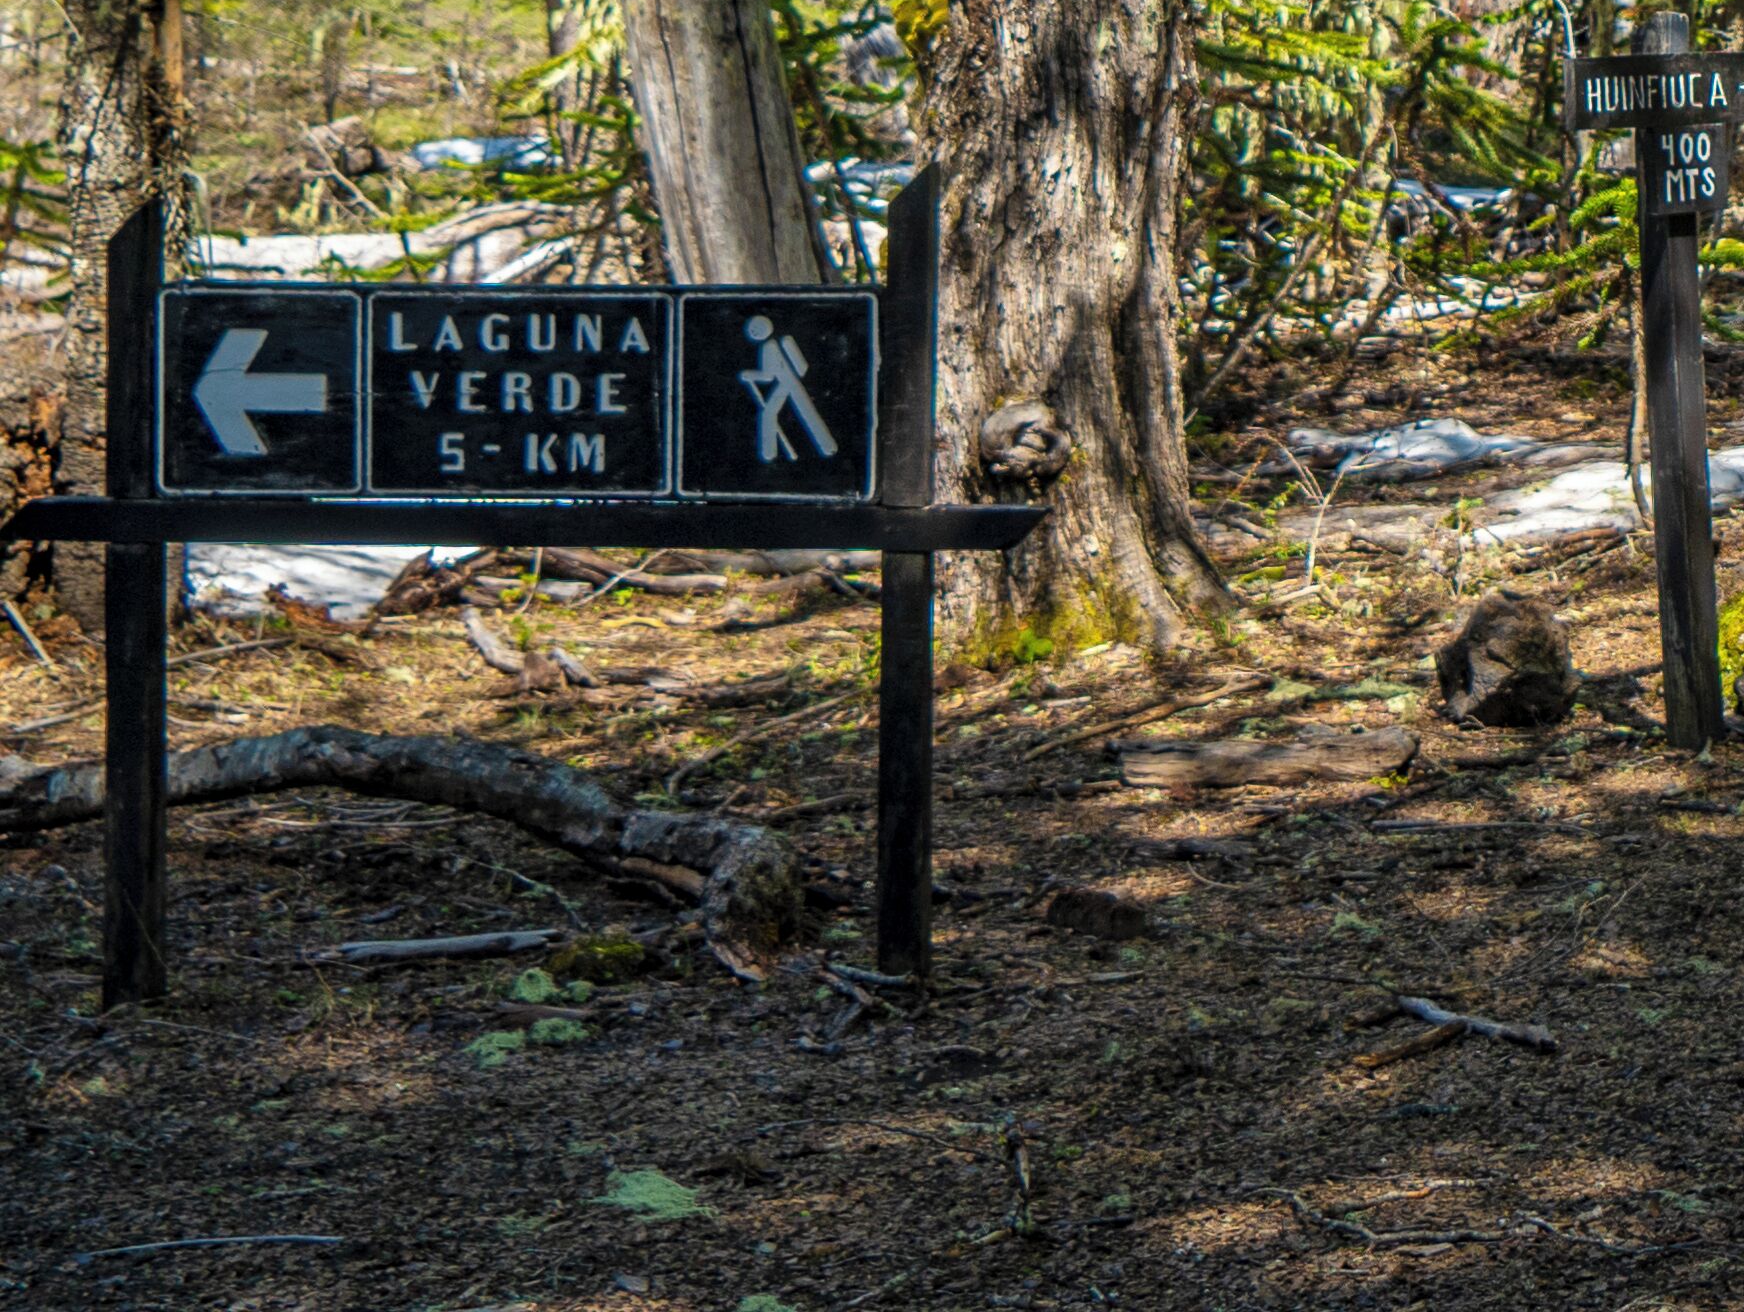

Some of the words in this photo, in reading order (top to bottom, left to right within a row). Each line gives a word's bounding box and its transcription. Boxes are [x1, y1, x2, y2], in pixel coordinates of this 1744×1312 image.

[1660, 131, 1711, 166] 400
[1665, 166, 1716, 203] MTS
[388, 311, 650, 353] LAGUNA
[409, 370, 628, 414] VERDE
